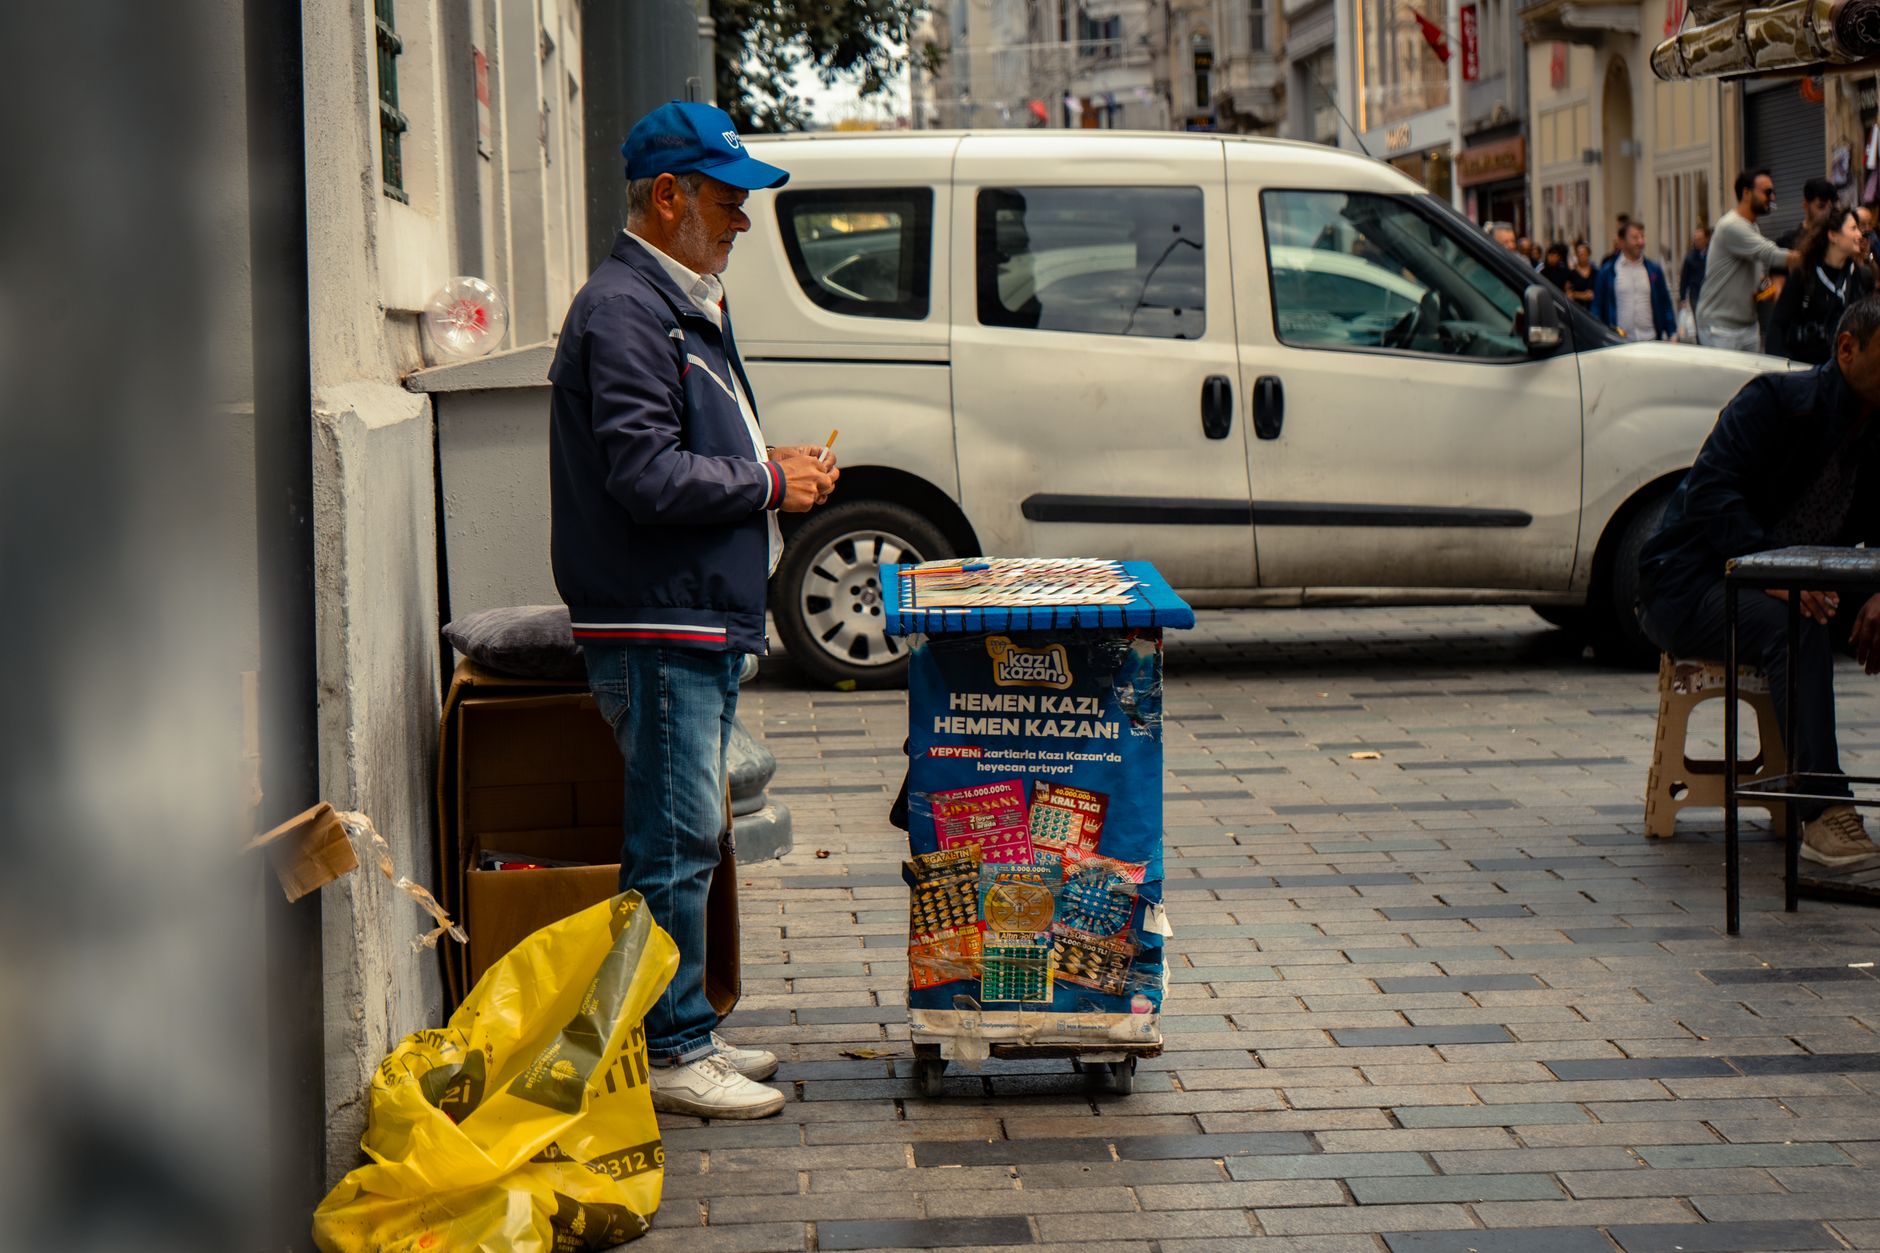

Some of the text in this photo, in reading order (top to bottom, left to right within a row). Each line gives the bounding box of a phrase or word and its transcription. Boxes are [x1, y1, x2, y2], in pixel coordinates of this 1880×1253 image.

[1008, 650, 1050, 668] kazı
[949, 693, 1105, 718] HEMEN KAZI,
[933, 716, 1120, 740] HEMEN KAZAN!
[1038, 751, 1064, 760] Kazı
[977, 761, 1074, 775] heyecan artıyor!
[1050, 795, 1077, 808] KRAL
